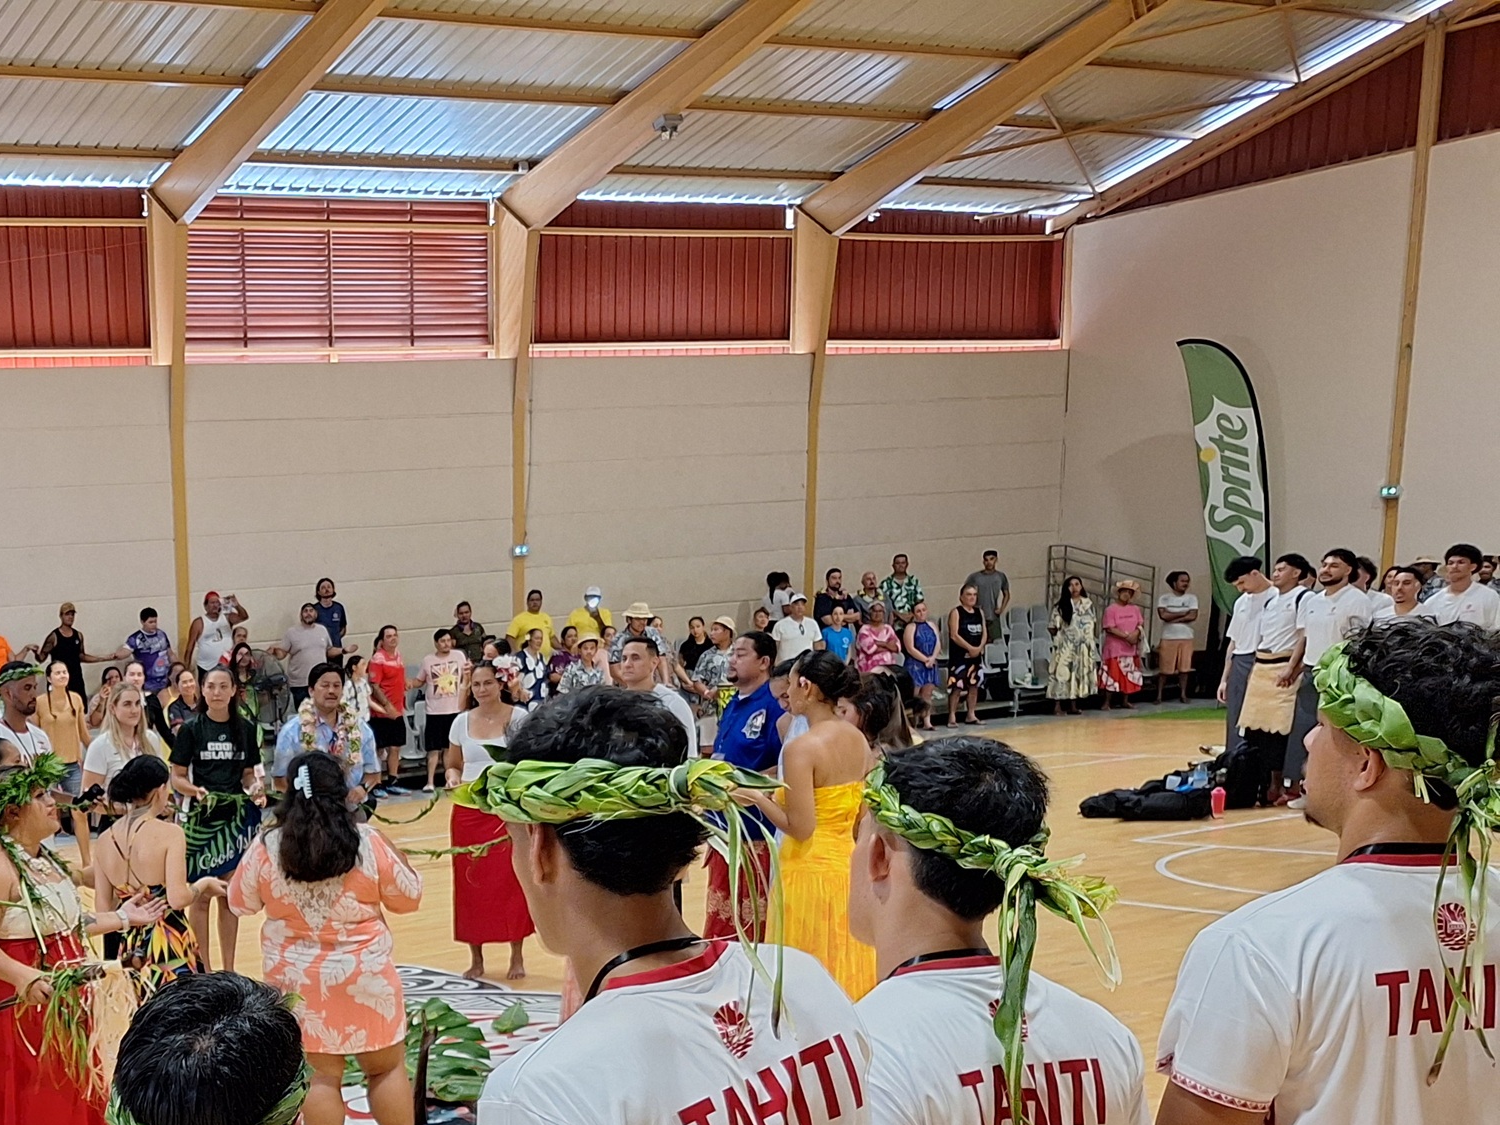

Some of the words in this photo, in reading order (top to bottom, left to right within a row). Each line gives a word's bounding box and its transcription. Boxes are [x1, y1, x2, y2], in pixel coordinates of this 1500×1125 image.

[1202, 413, 1263, 548] Sprite
[200, 751, 245, 760] ISLAN
[207, 741, 236, 751] COO
[199, 842, 235, 870] Cook
